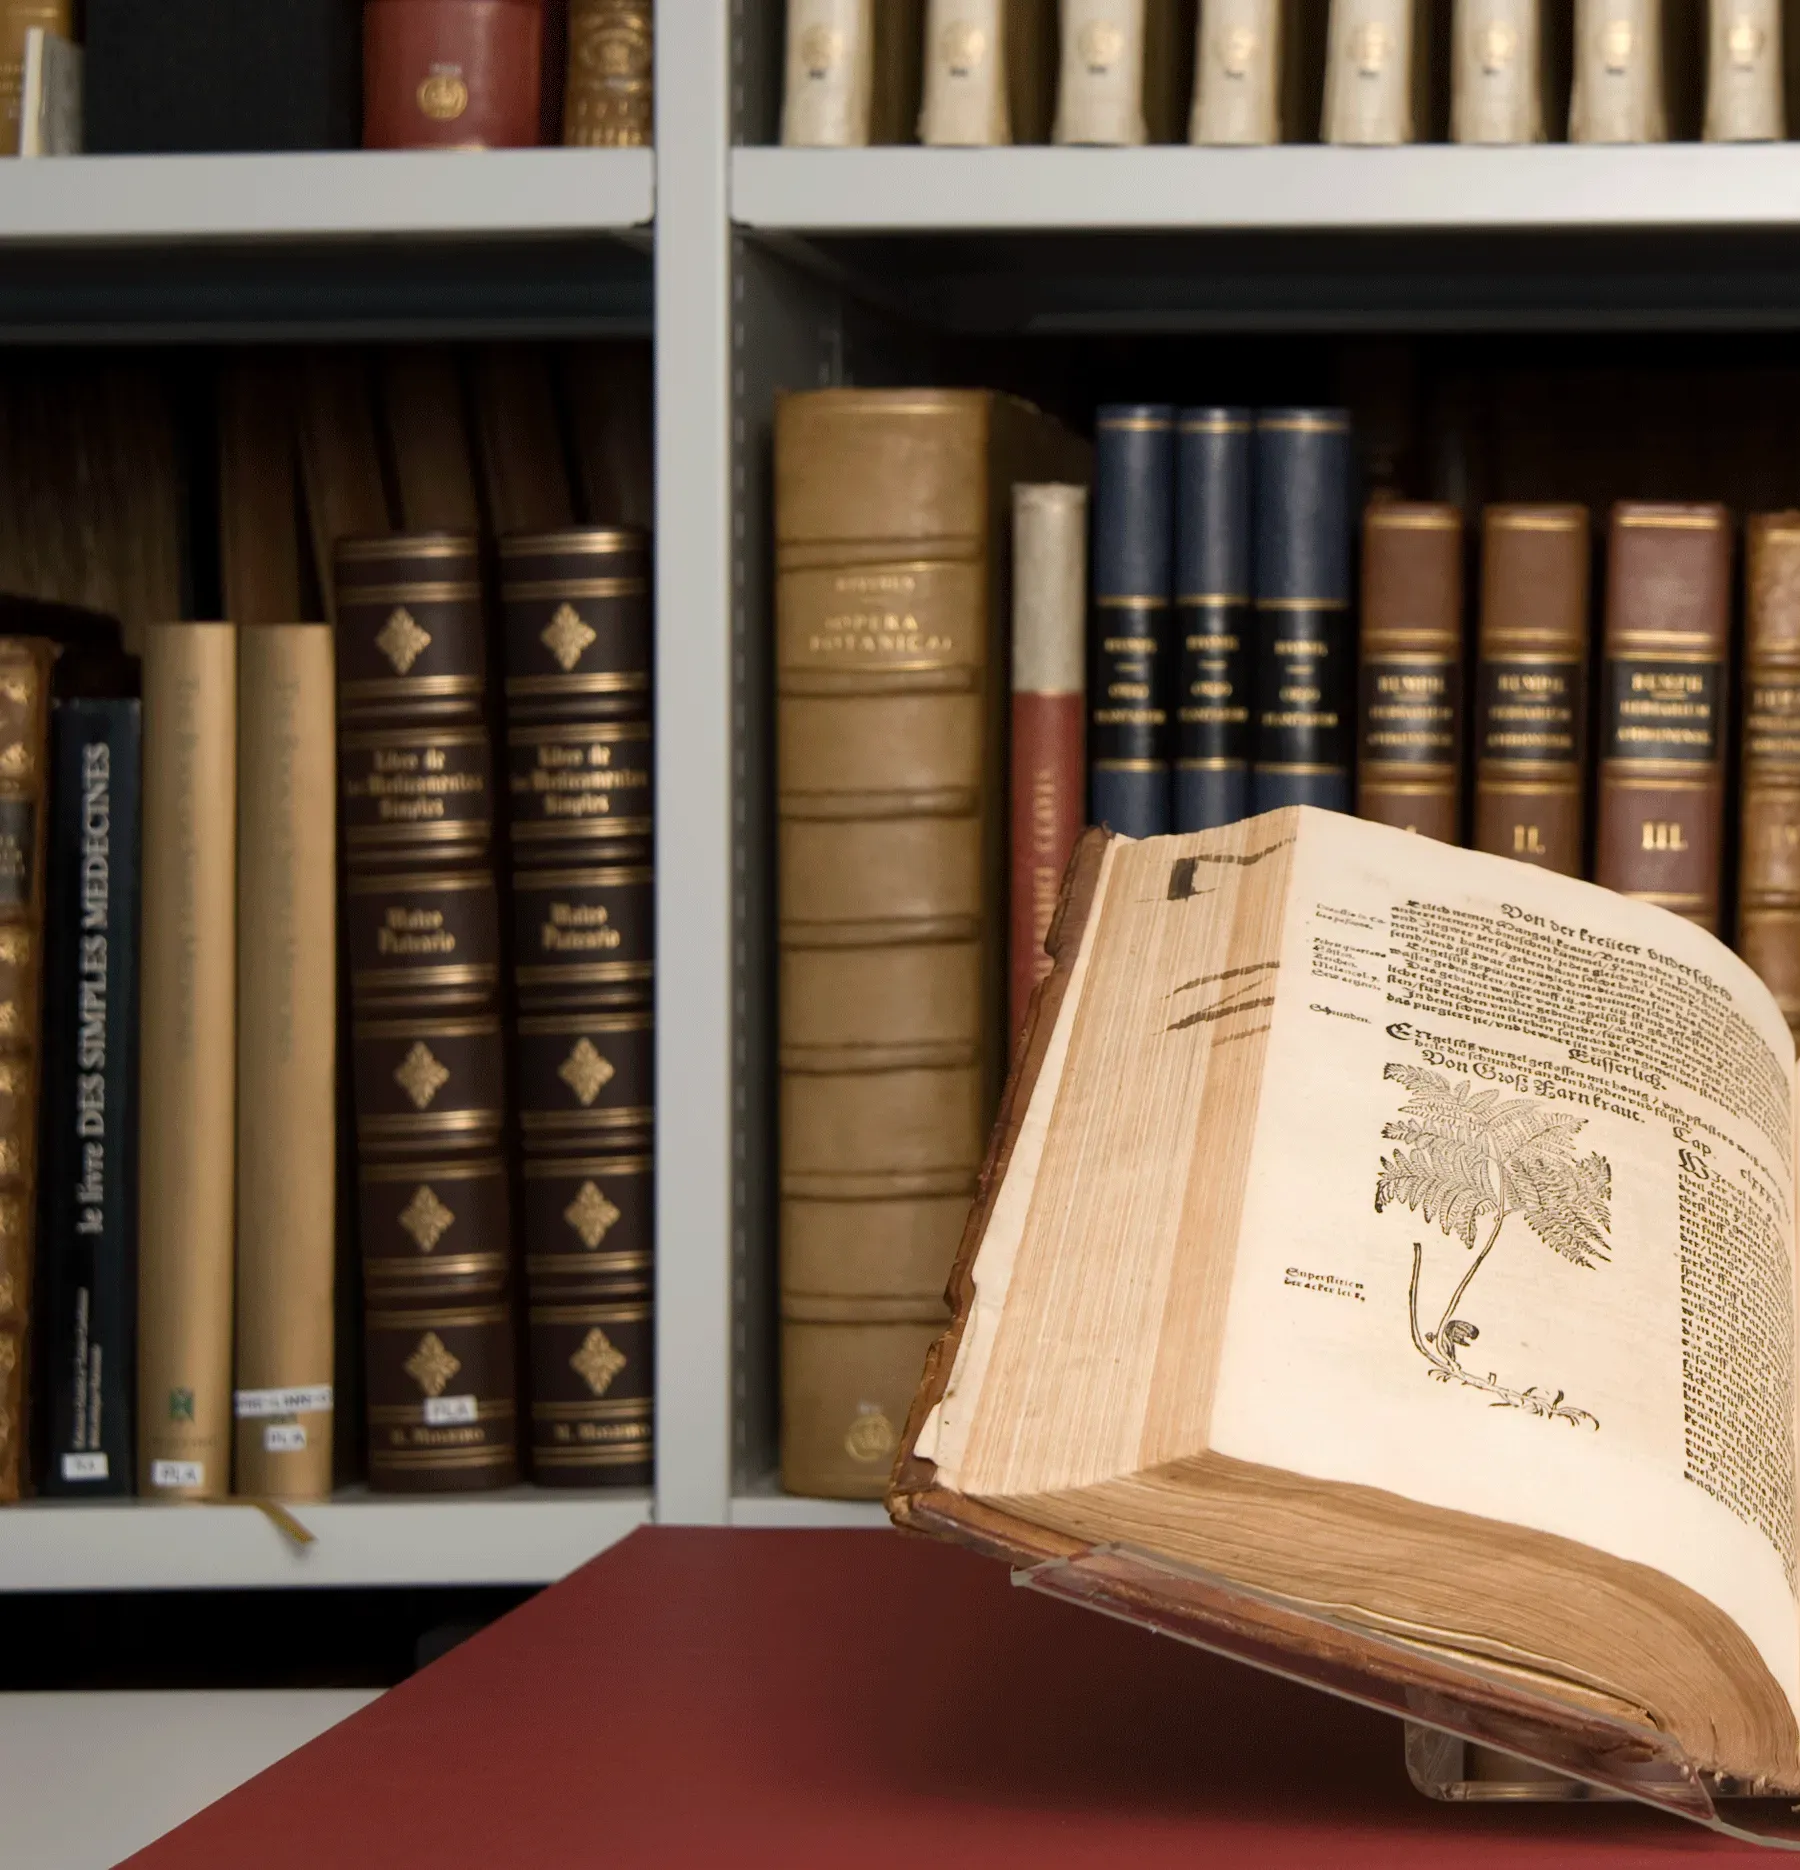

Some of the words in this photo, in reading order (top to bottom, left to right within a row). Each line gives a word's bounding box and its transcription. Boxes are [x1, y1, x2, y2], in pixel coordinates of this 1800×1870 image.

[82, 741, 110, 930] MEDECINES
[78, 934, 108, 1068] SIMPLES
[76, 1072, 106, 1138] DES
[1421, 1049, 1469, 1074] Von
